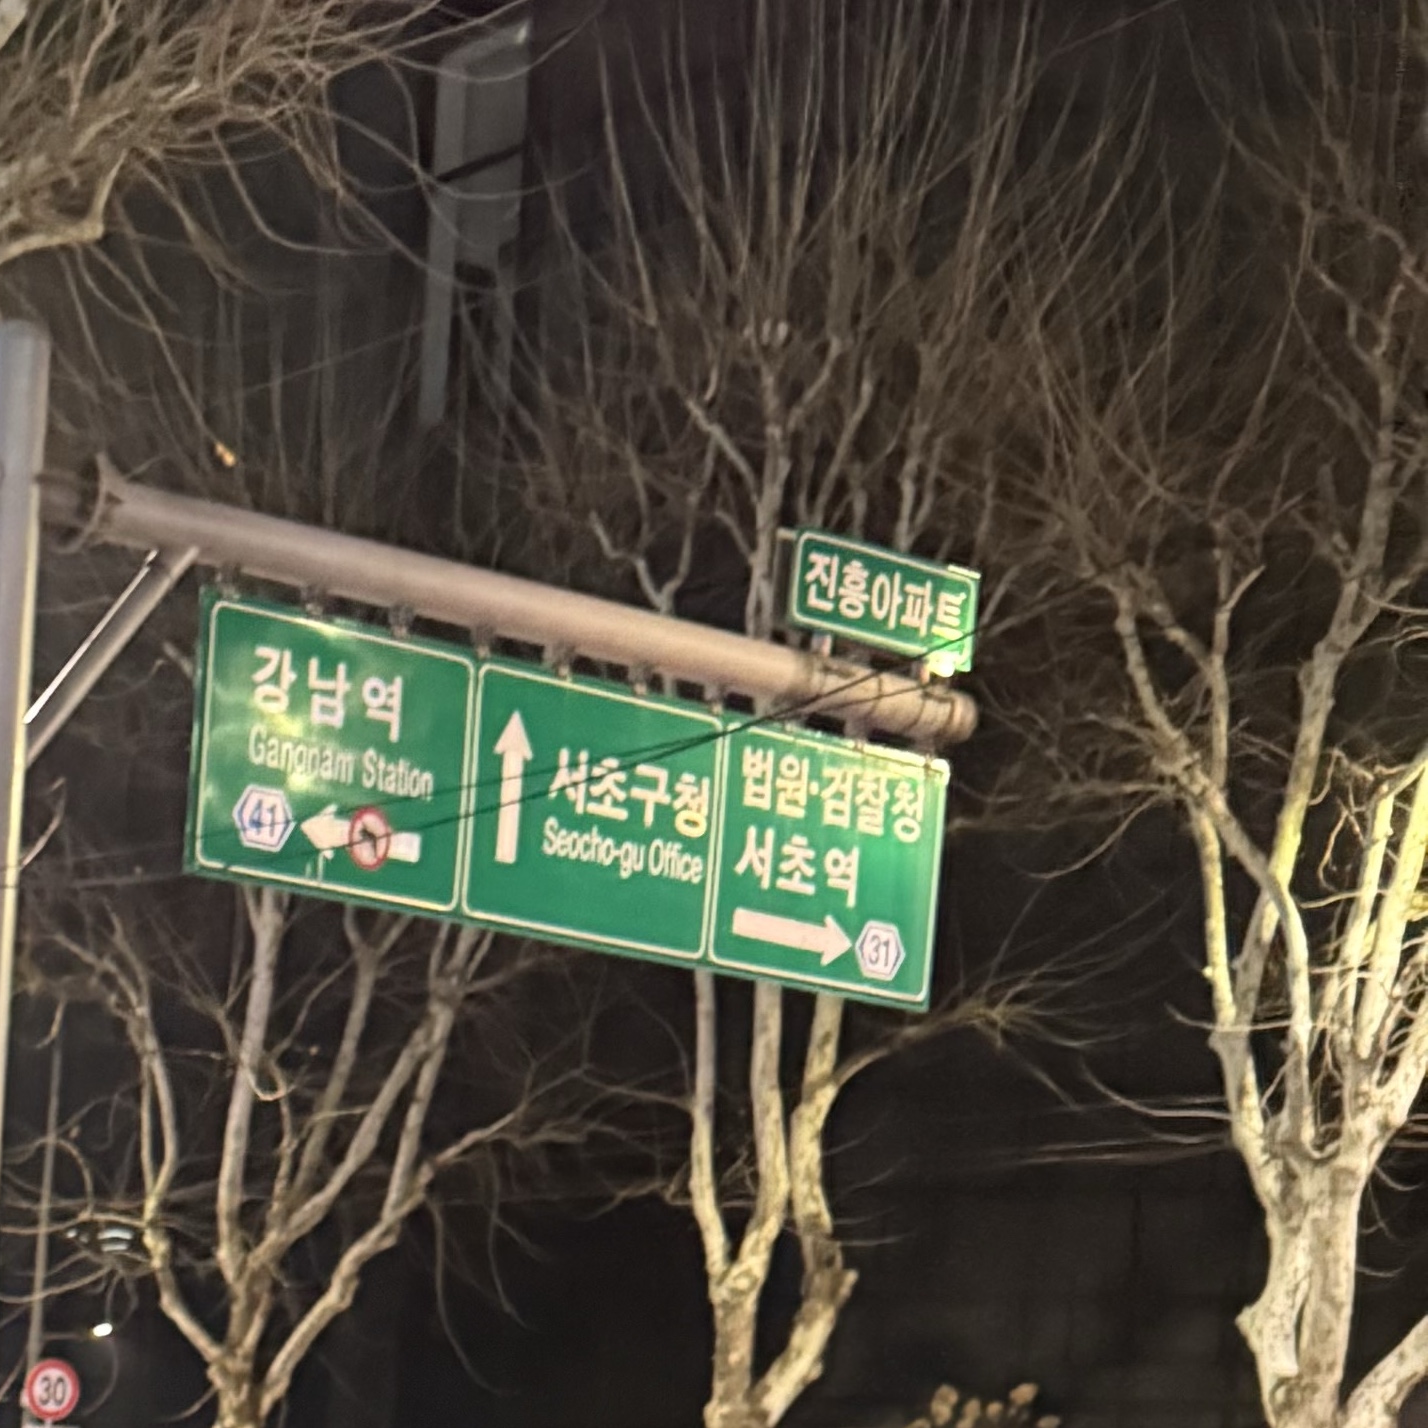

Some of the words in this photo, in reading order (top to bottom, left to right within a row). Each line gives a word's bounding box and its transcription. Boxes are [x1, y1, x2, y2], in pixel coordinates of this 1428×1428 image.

[805, 552, 966, 640] 진흥아파트
[248, 723, 354, 788] Gangnam
[361, 747, 434, 800] Station
[548, 748, 710, 838] 서초구청
[250, 798, 277, 838] 41
[543, 816, 645, 879] Seocho-gu
[648, 838, 704, 884] Office
[867, 934, 891, 968] 31
[39, 1375, 66, 1406] 30
